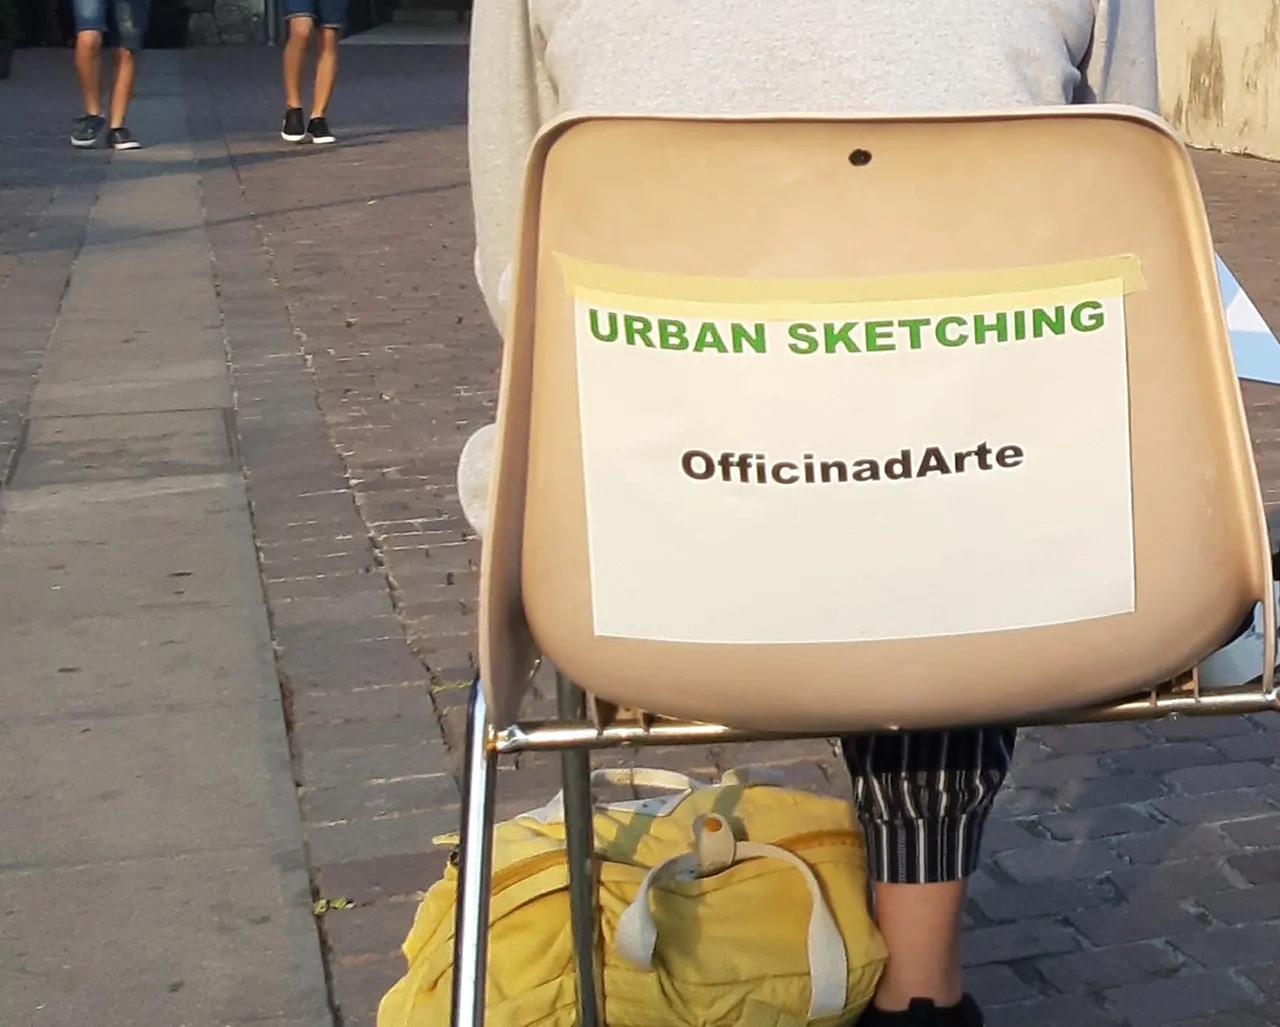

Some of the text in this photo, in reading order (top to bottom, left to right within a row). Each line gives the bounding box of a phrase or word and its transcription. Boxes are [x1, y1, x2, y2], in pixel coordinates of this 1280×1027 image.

[588, 299, 1106, 355] URBAN SKETCHING
[680, 440, 1025, 485] OfficinadArte
